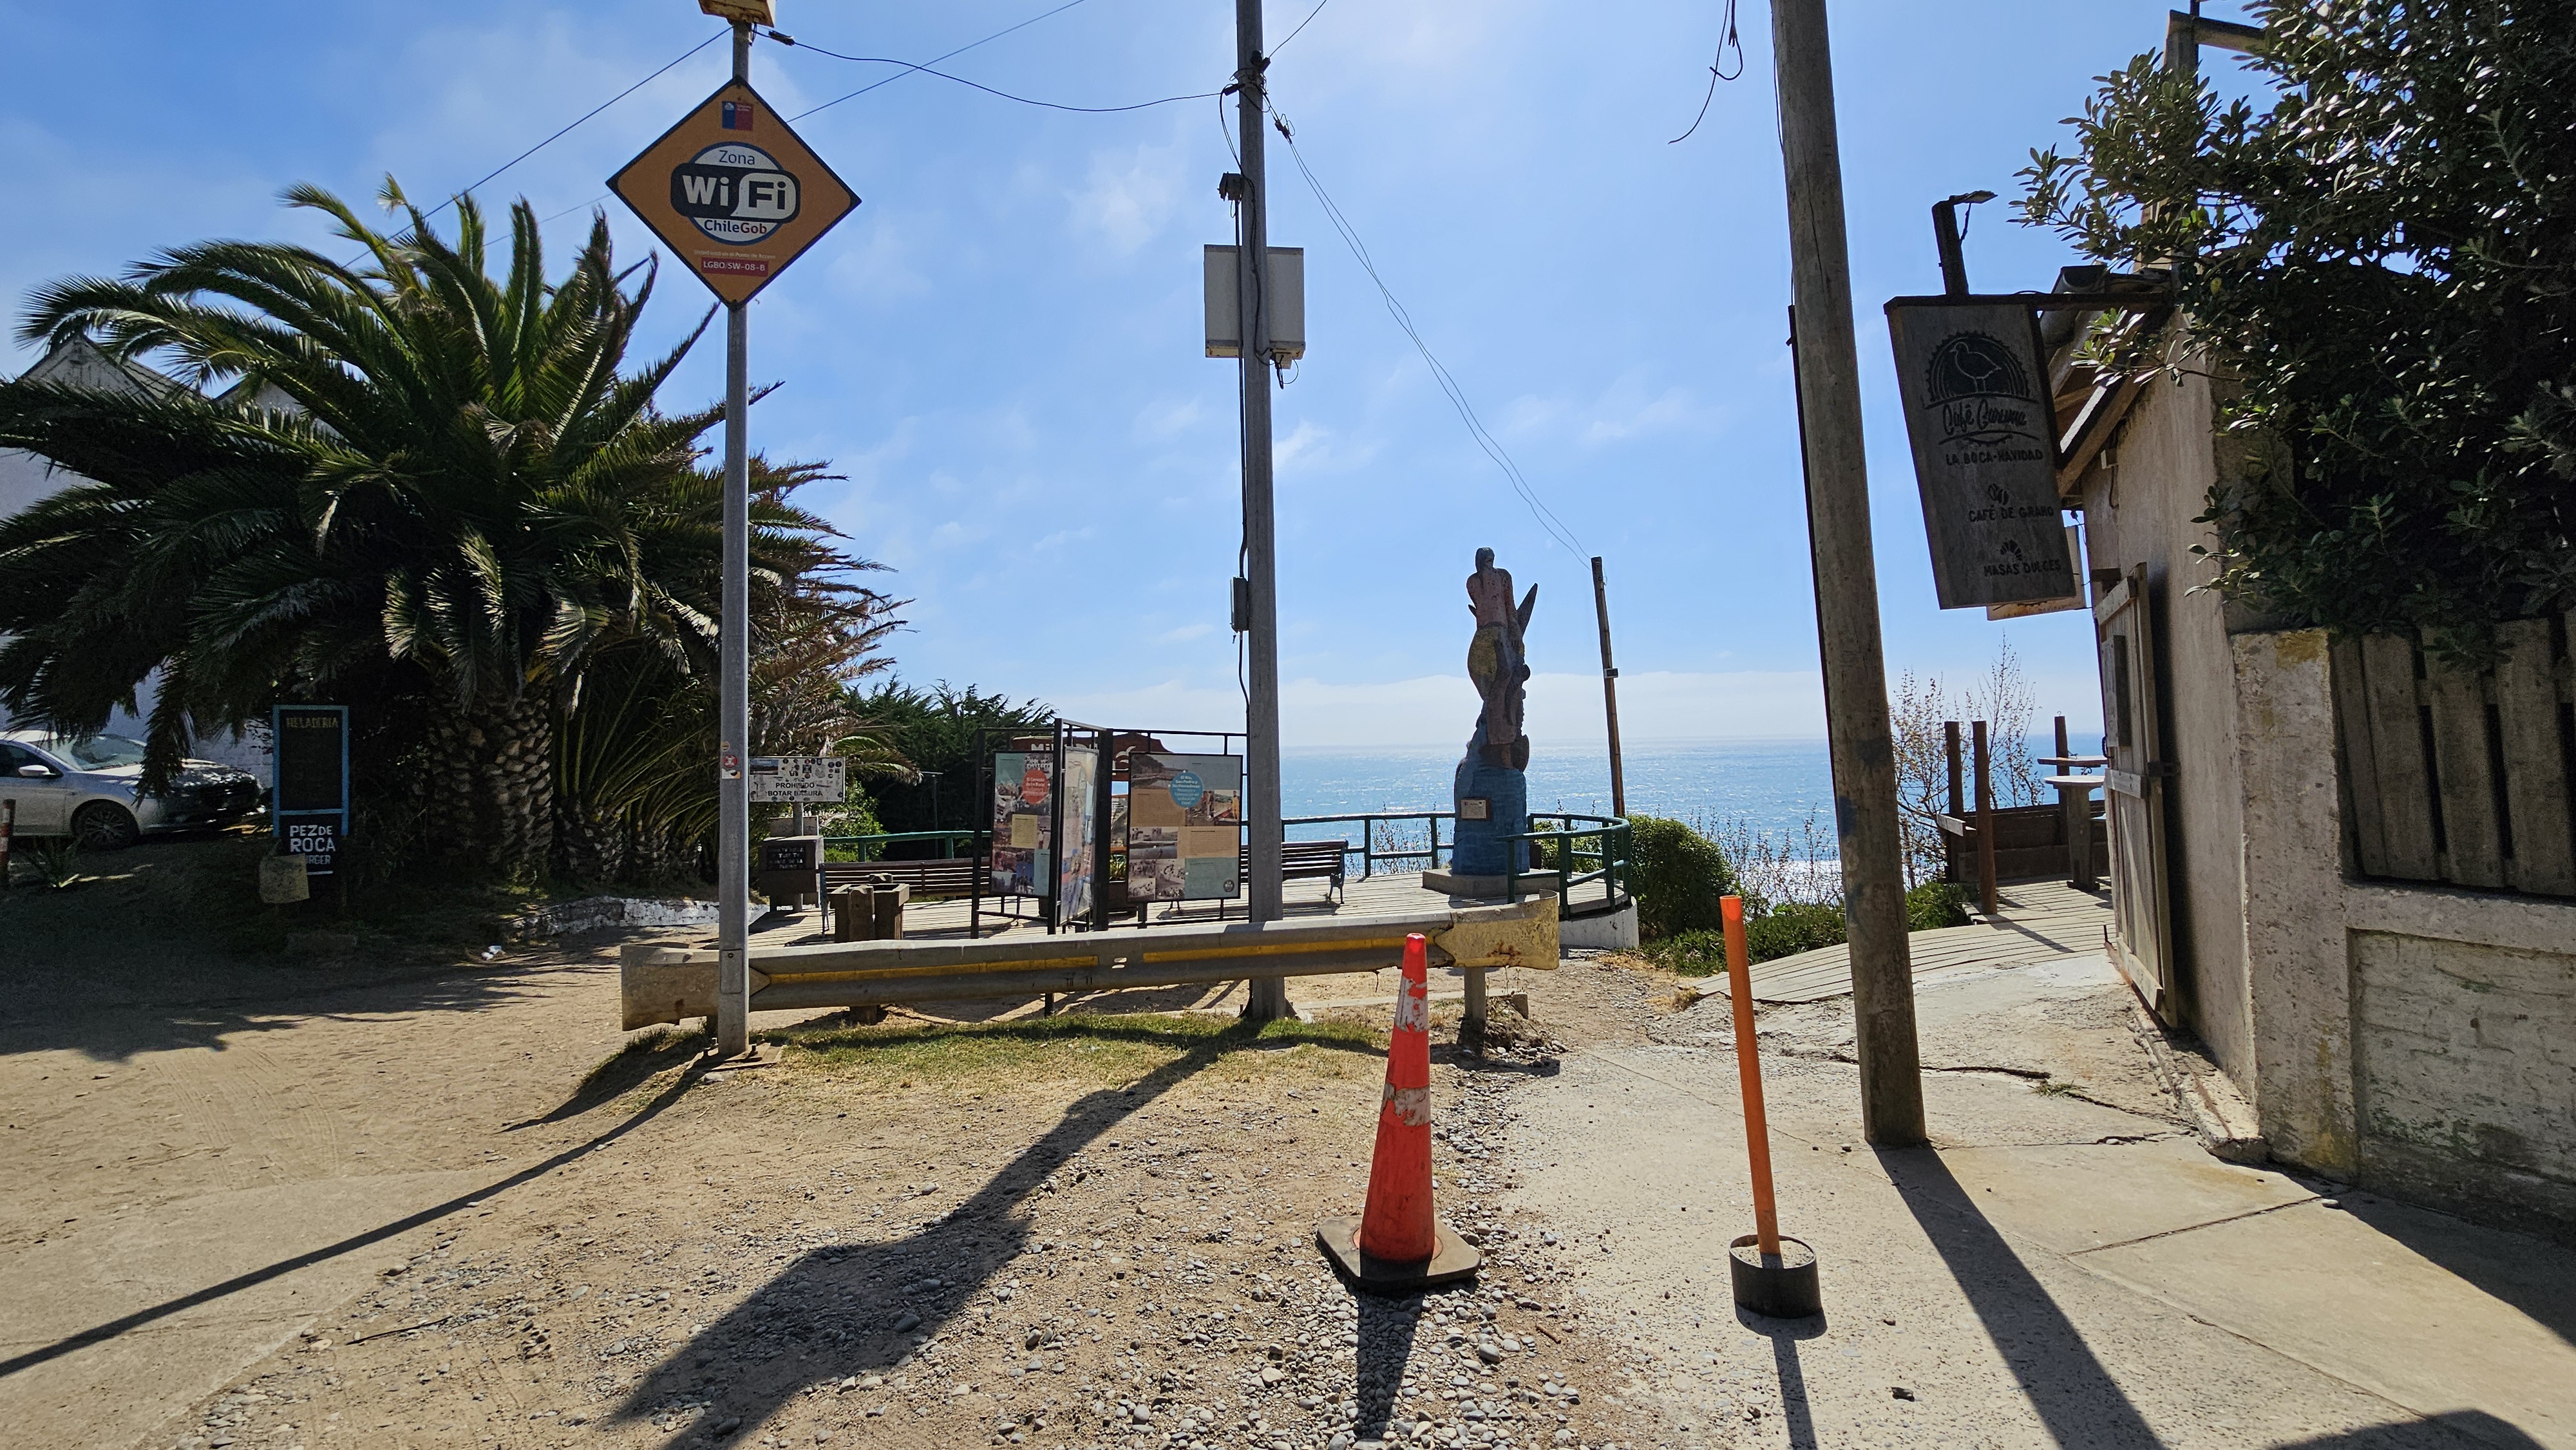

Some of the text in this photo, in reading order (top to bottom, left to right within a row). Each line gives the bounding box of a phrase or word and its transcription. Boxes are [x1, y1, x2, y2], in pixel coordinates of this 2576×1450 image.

[719, 150, 755, 165] Zona
[704, 220, 768, 234] ChileGob
[1946, 453, 1960, 466] LA
[2000, 506, 2015, 519] DE
[2019, 505, 2054, 518] GRANO
[1984, 558, 2061, 576] MASAS DULCES
[289, 825, 333, 837] PEZ DE
[290, 837, 336, 852] ROCA
